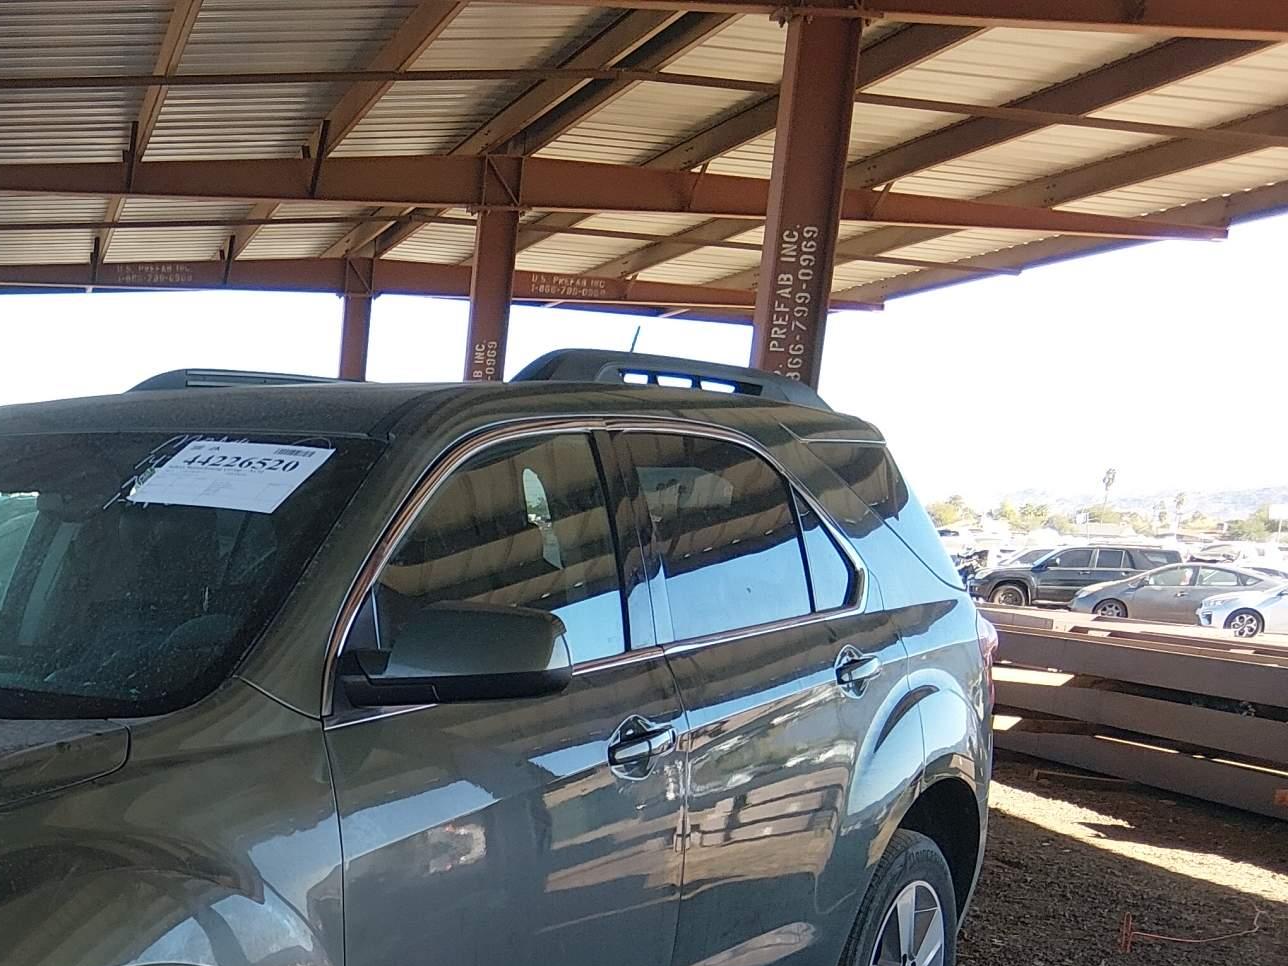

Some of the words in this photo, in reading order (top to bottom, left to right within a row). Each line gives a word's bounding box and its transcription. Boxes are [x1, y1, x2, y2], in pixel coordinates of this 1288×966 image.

[780, 223, 801, 262] INC.
[769, 272, 794, 352] PREFAB
[183, 454, 300, 472] 44226520
